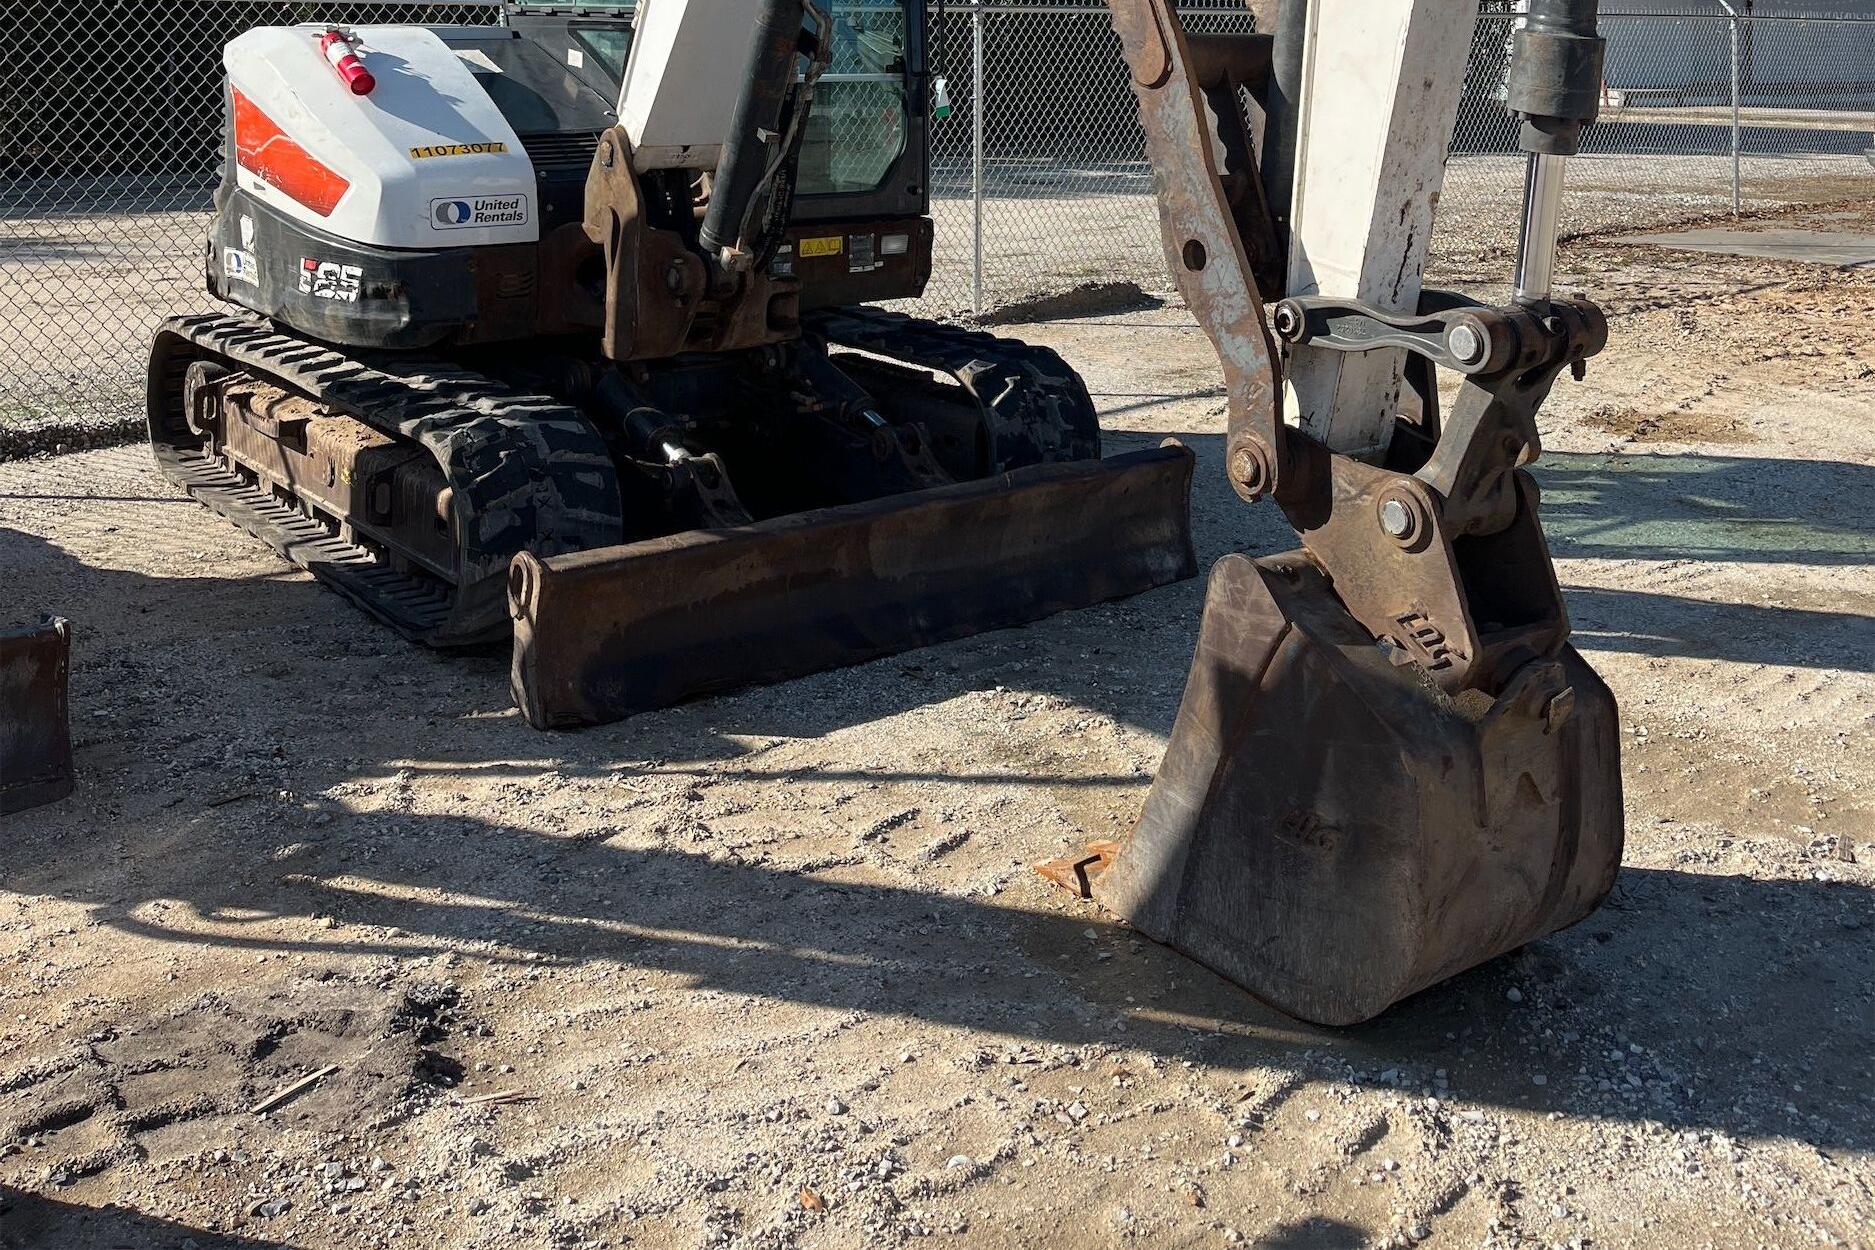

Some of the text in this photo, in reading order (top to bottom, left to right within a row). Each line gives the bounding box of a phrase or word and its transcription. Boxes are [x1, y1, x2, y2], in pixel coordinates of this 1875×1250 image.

[411, 142, 504, 158] 11073077
[474, 199, 519, 211] United
[474, 210, 523, 223] Rentals
